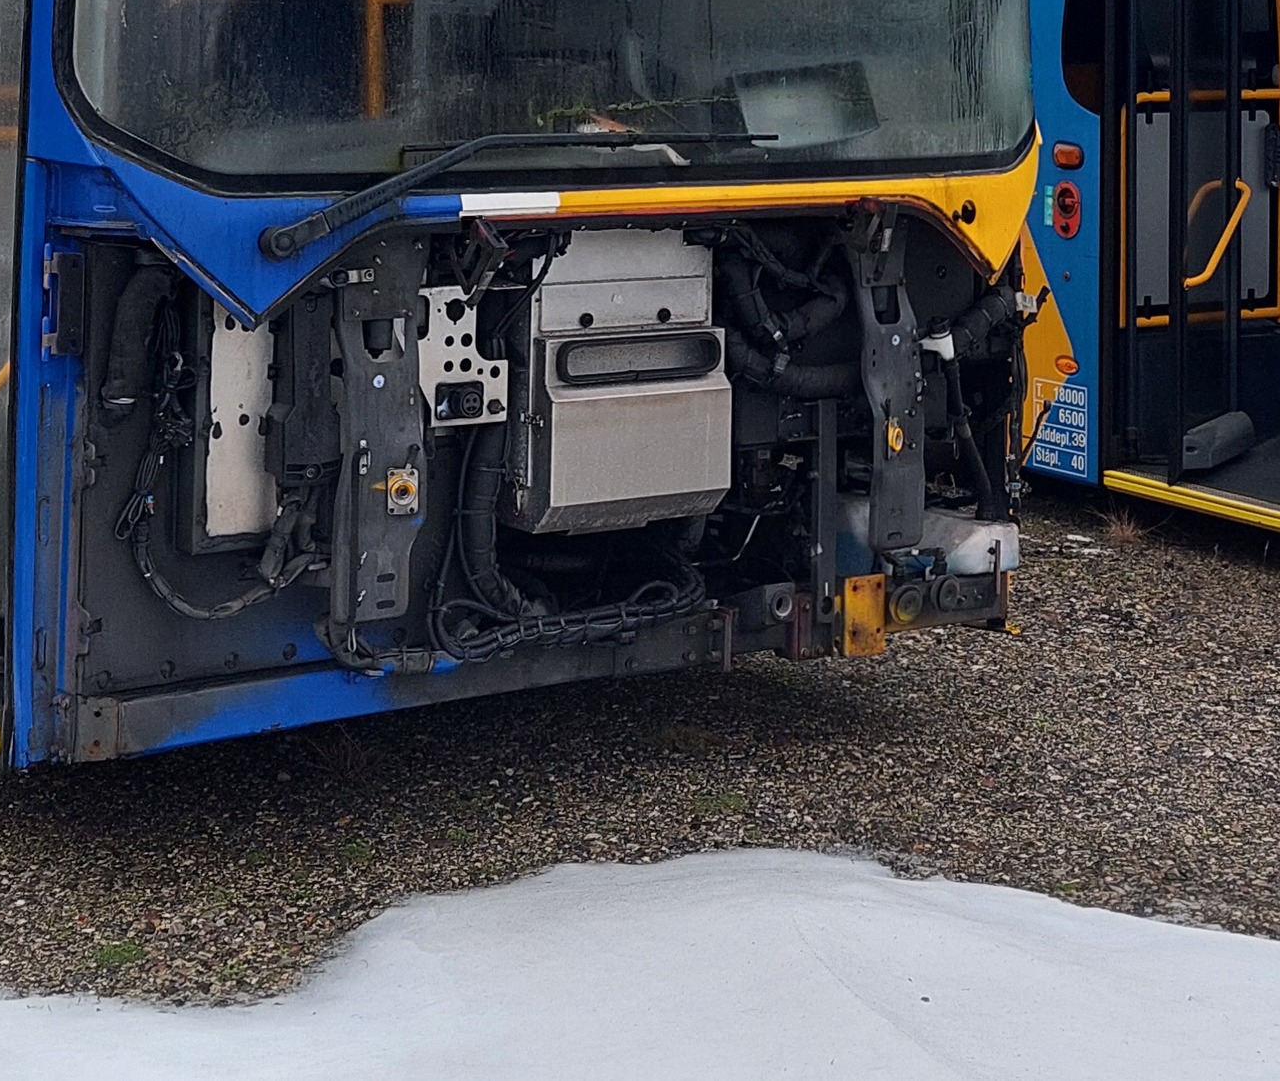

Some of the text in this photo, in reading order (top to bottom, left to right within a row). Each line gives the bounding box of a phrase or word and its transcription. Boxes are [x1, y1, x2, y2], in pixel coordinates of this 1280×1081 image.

[1053, 386, 1085, 406] 18000
[1058, 408, 1085, 427] 6500
[1071, 455, 1084, 471] 40
